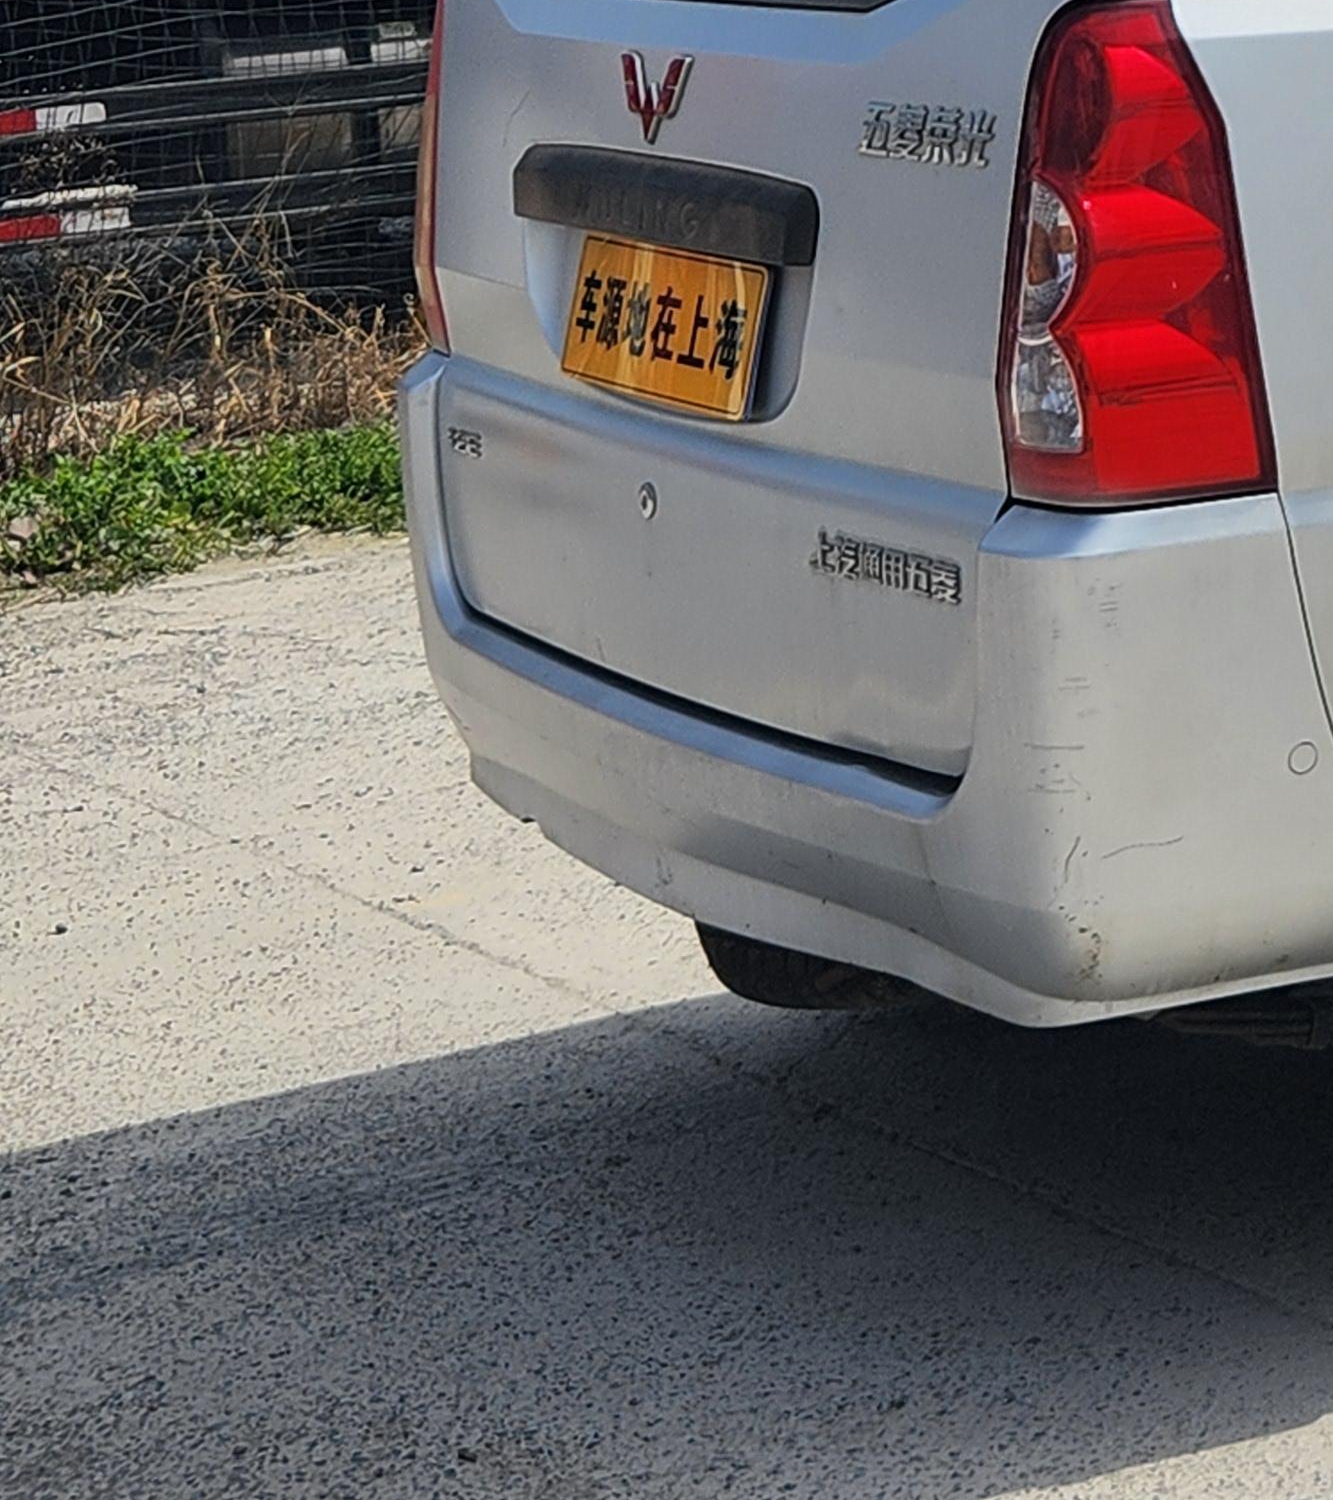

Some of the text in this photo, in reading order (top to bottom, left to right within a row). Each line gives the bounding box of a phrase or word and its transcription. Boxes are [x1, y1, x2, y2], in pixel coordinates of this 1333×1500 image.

[859, 100, 998, 169] 五菱荣光
[573, 268, 748, 381] 车源地在上海
[809, 526, 963, 606] 上汽通用五菱
